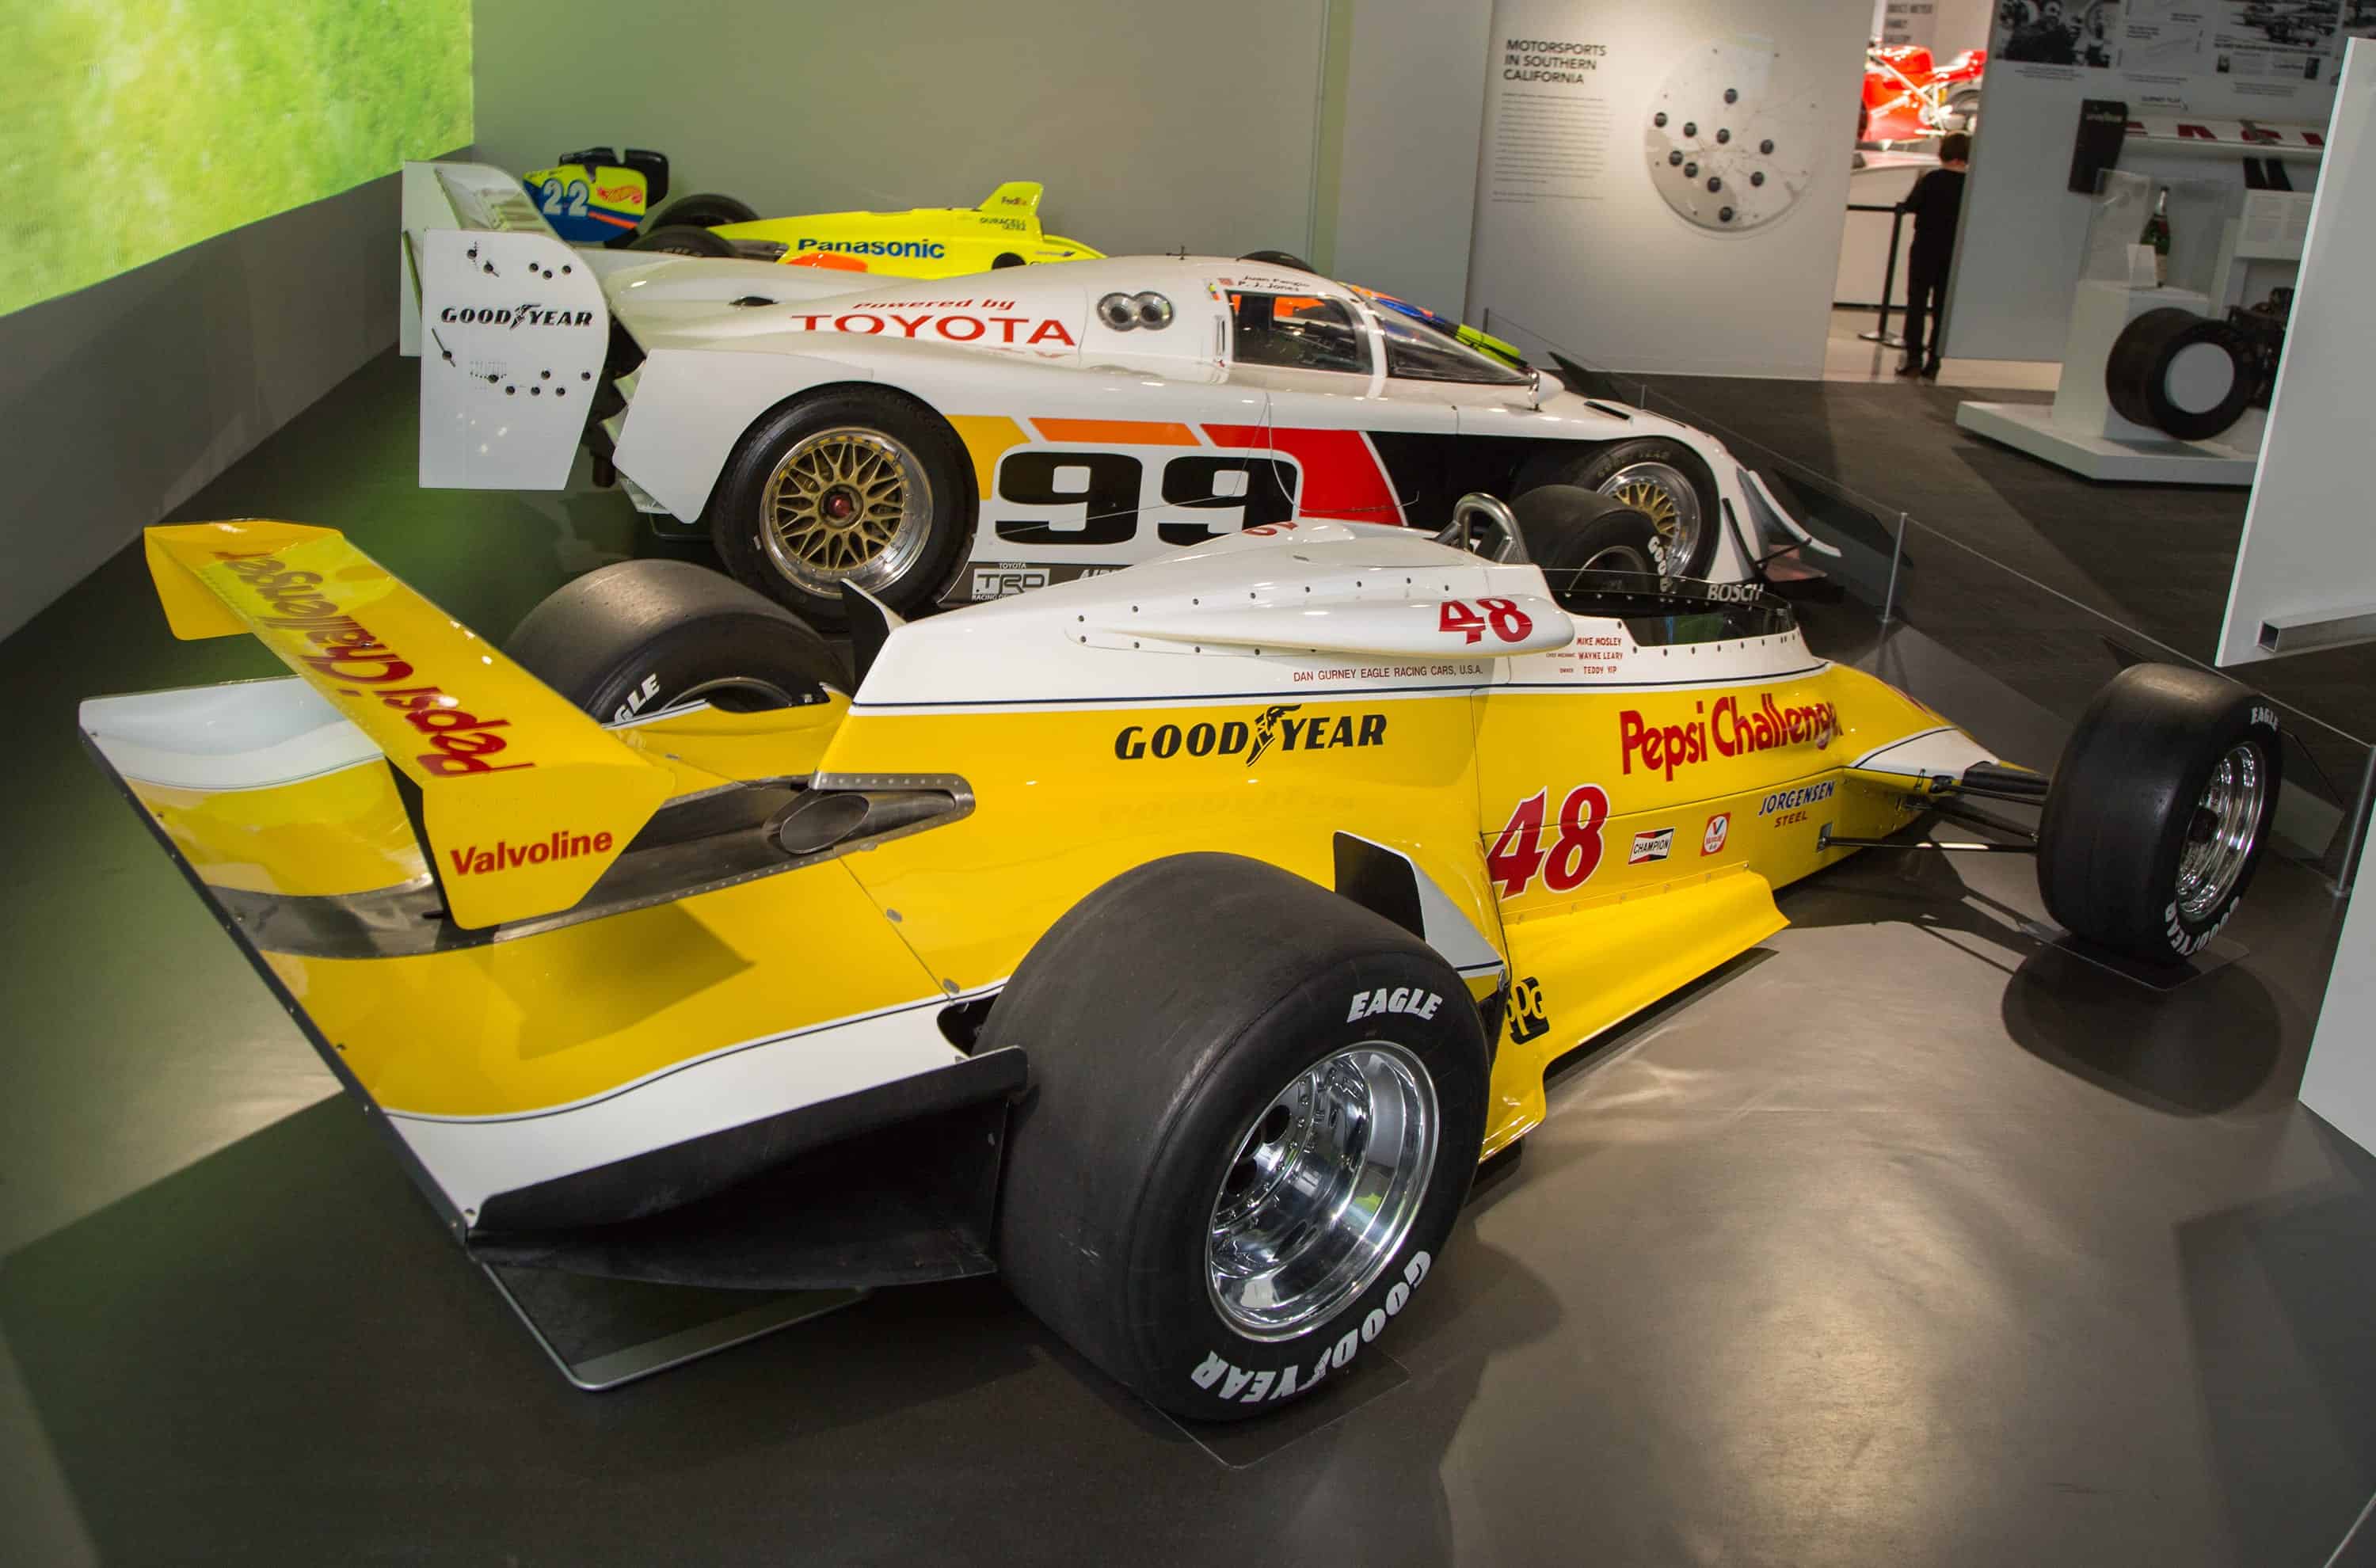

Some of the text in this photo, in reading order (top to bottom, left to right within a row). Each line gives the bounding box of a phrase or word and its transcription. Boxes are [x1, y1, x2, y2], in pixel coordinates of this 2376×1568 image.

[1506, 40, 1607, 56] MOTORSPORTS
[1505, 55, 1597, 70] IN SOUTHERN
[1503, 69, 1584, 84] CALIFORNIA
[543, 178, 589, 216] 22
[798, 237, 946, 260] Panasonic
[853, 298, 1016, 311] Powered by
[792, 314, 1076, 347] TOYOTA
[996, 451, 1301, 546] 99
[999, 561, 1027, 570] TOYOTA
[977, 573, 1045, 595] TRD
[1708, 584, 1765, 603] BOSCH
[1438, 598, 1533, 644] 48
[1577, 637, 1622, 646] MIKE MOSLEY
[1293, 664, 1483, 683] DAN GURNEY EAGLE RACING CARS, U.S.A.
[1584, 666, 1604, 675] TEDDY
[2250, 706, 2279, 733] EAGLE
[340, 686, 535, 779] Pepsi
[1620, 701, 1708, 782] Pepsi
[1757, 778, 1836, 816] JORGENSEN
[1774, 810, 1809, 828] STEEL
[1488, 783, 1611, 901] 48
[1632, 836, 1670, 855] CHAMPION
[450, 832, 613, 877] Valvoline
[1346, 987, 1444, 1024] EAGLE
